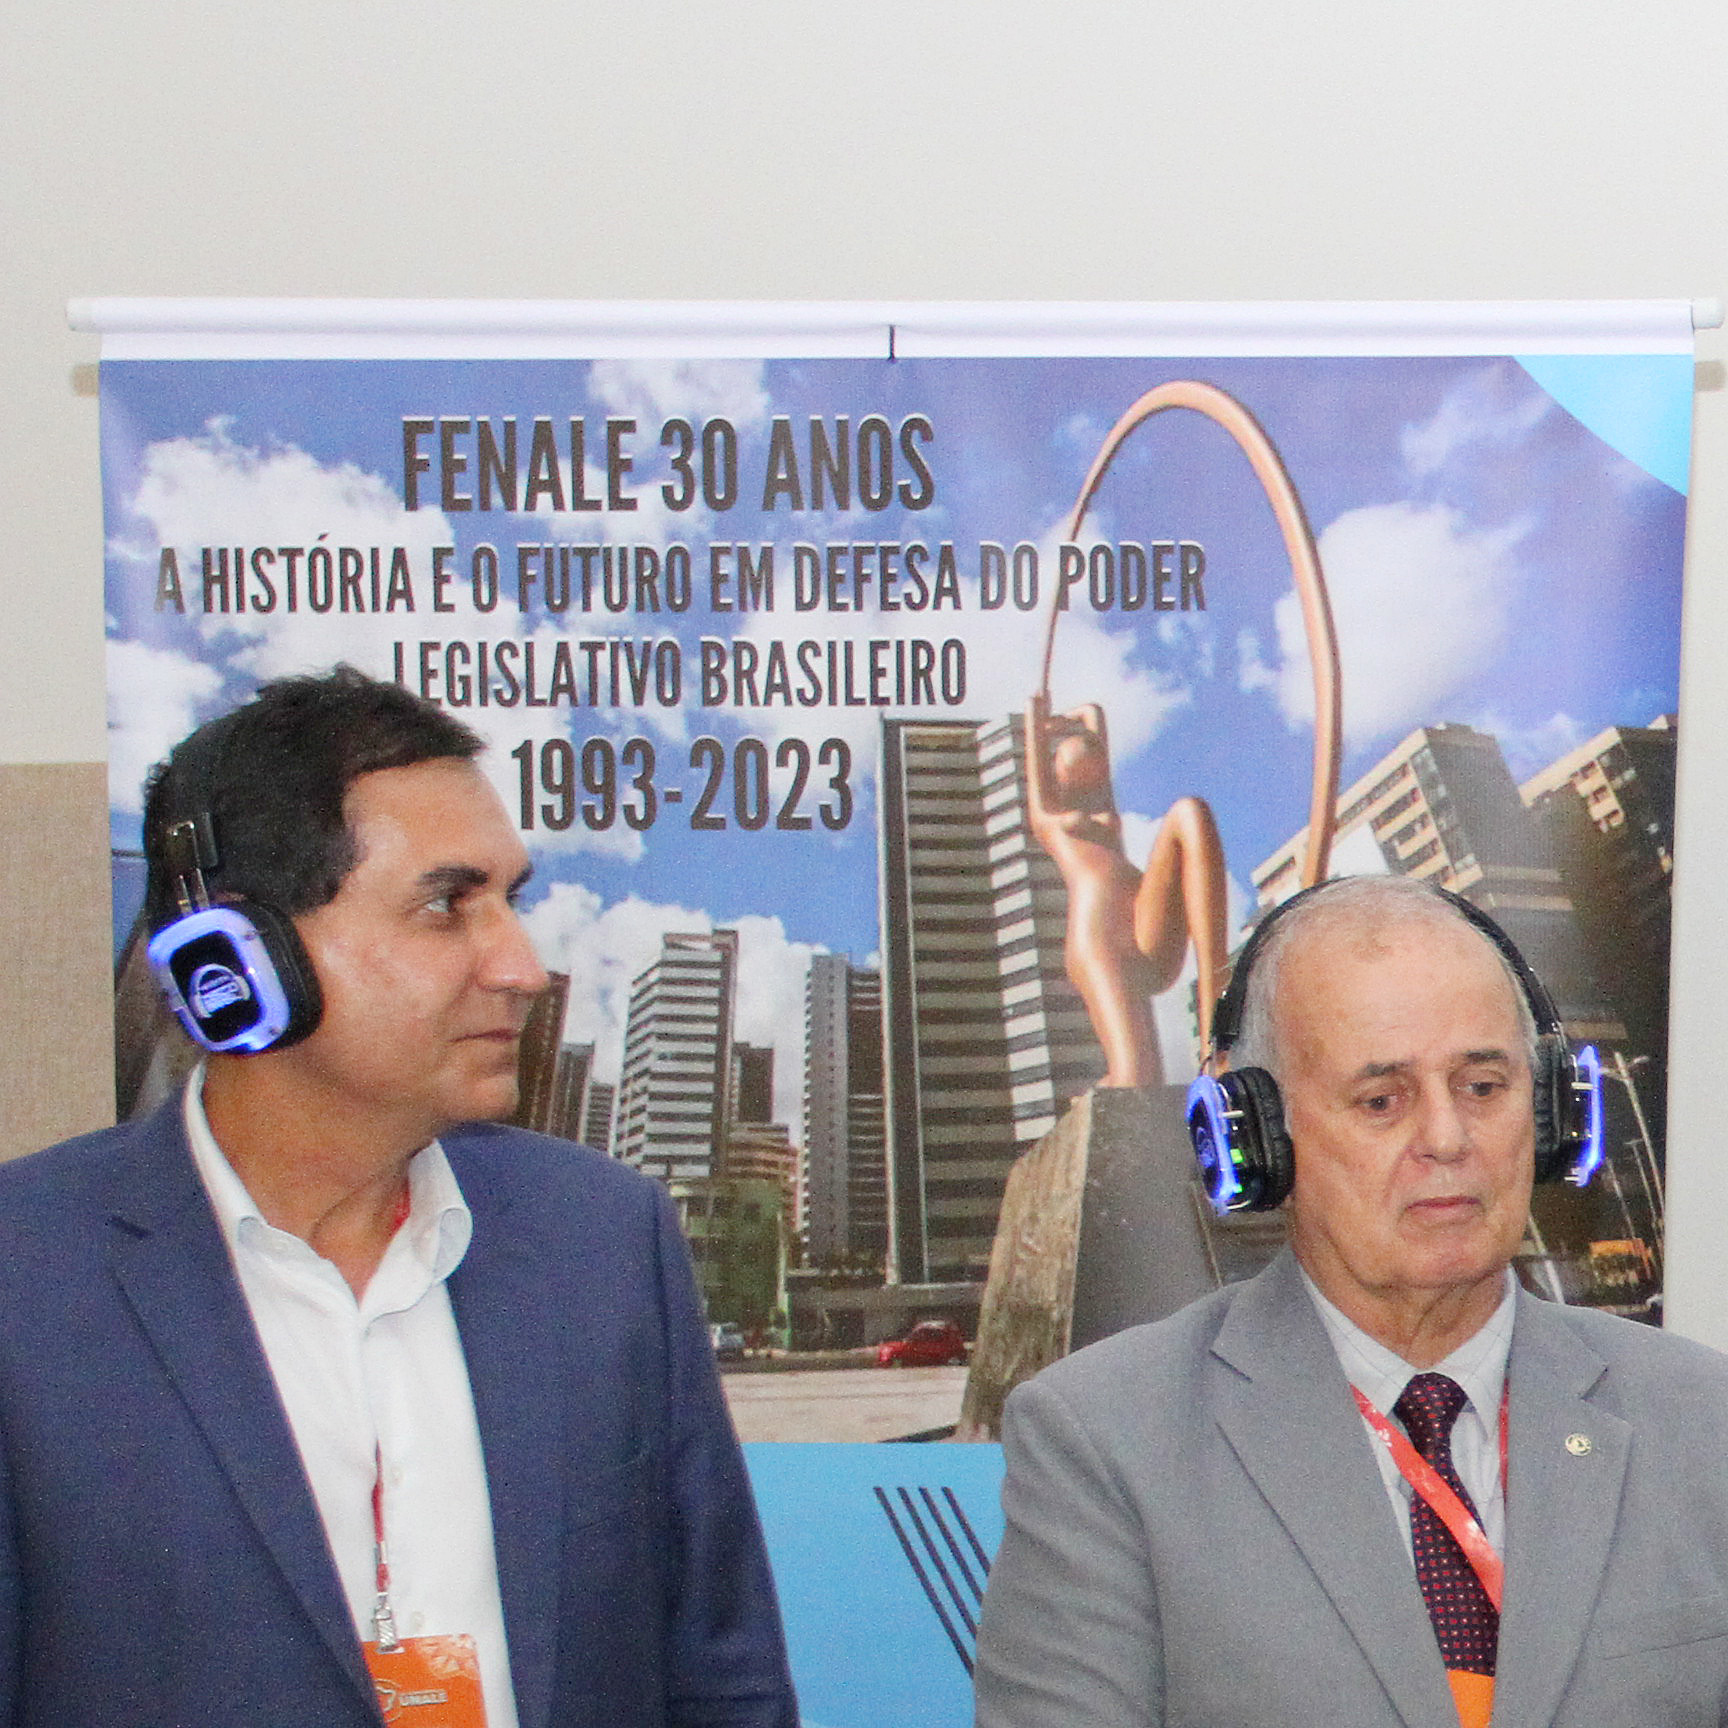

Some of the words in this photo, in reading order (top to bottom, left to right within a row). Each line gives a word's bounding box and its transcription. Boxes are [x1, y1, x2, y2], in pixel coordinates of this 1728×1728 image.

[402, 414, 637, 512] FENALE
[660, 416, 738, 512] 30
[762, 414, 934, 512] ANOS
[154, 546, 185, 613] A
[202, 533, 416, 613] HISTÓRIA
[432, 546, 456, 613] E
[471, 546, 499, 613] O
[518, 543, 692, 613] FUTURO
[709, 543, 774, 613] EM
[794, 542, 962, 613] DEFESA
[979, 541, 1040, 611] DO
[1058, 540, 1208, 612] PODER
[700, 638, 967, 708] BRASILEIRO
[511, 736, 853, 832] 1993-2023
